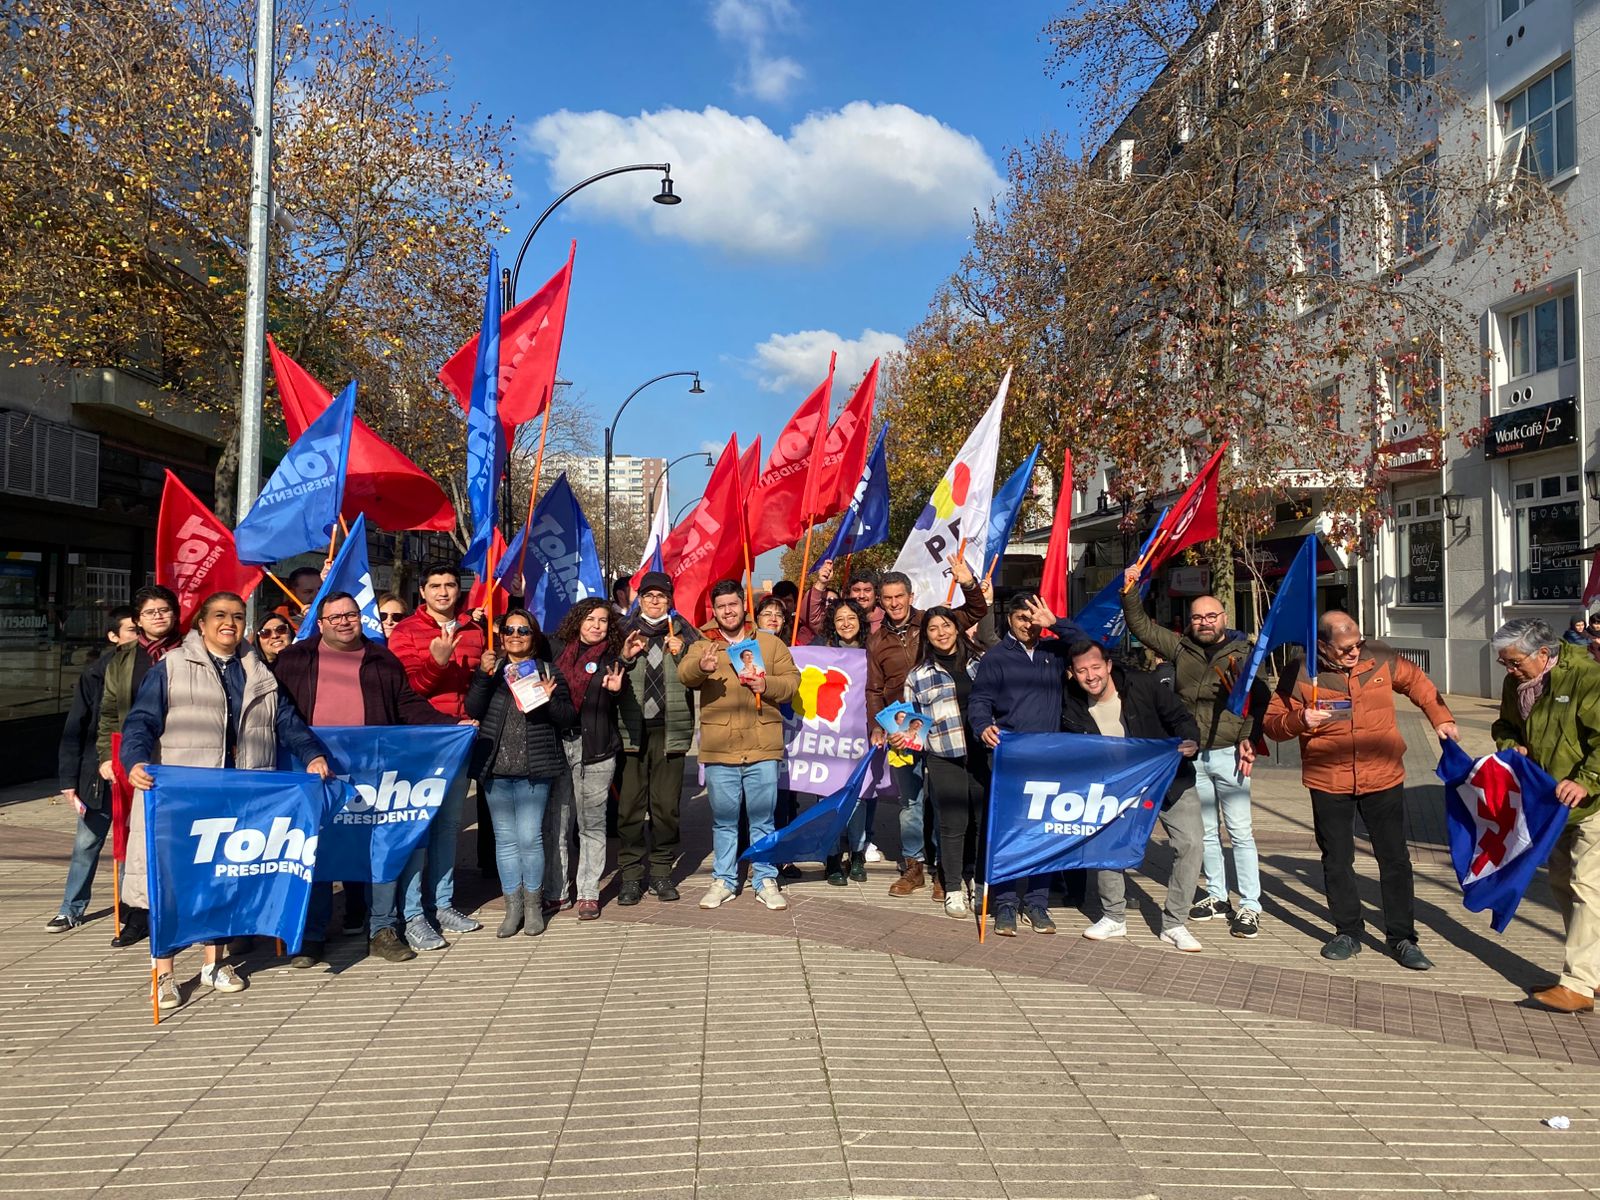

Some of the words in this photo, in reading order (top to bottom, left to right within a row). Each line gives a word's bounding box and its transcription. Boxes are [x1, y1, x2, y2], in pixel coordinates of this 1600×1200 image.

[1495, 426, 1520, 444] Work
[1520, 420, 1543, 438] Café
[336, 768, 447, 813] ohá
[333, 809, 430, 824] PRESIDENTA
[215, 861, 312, 883] PRESIDENTA
